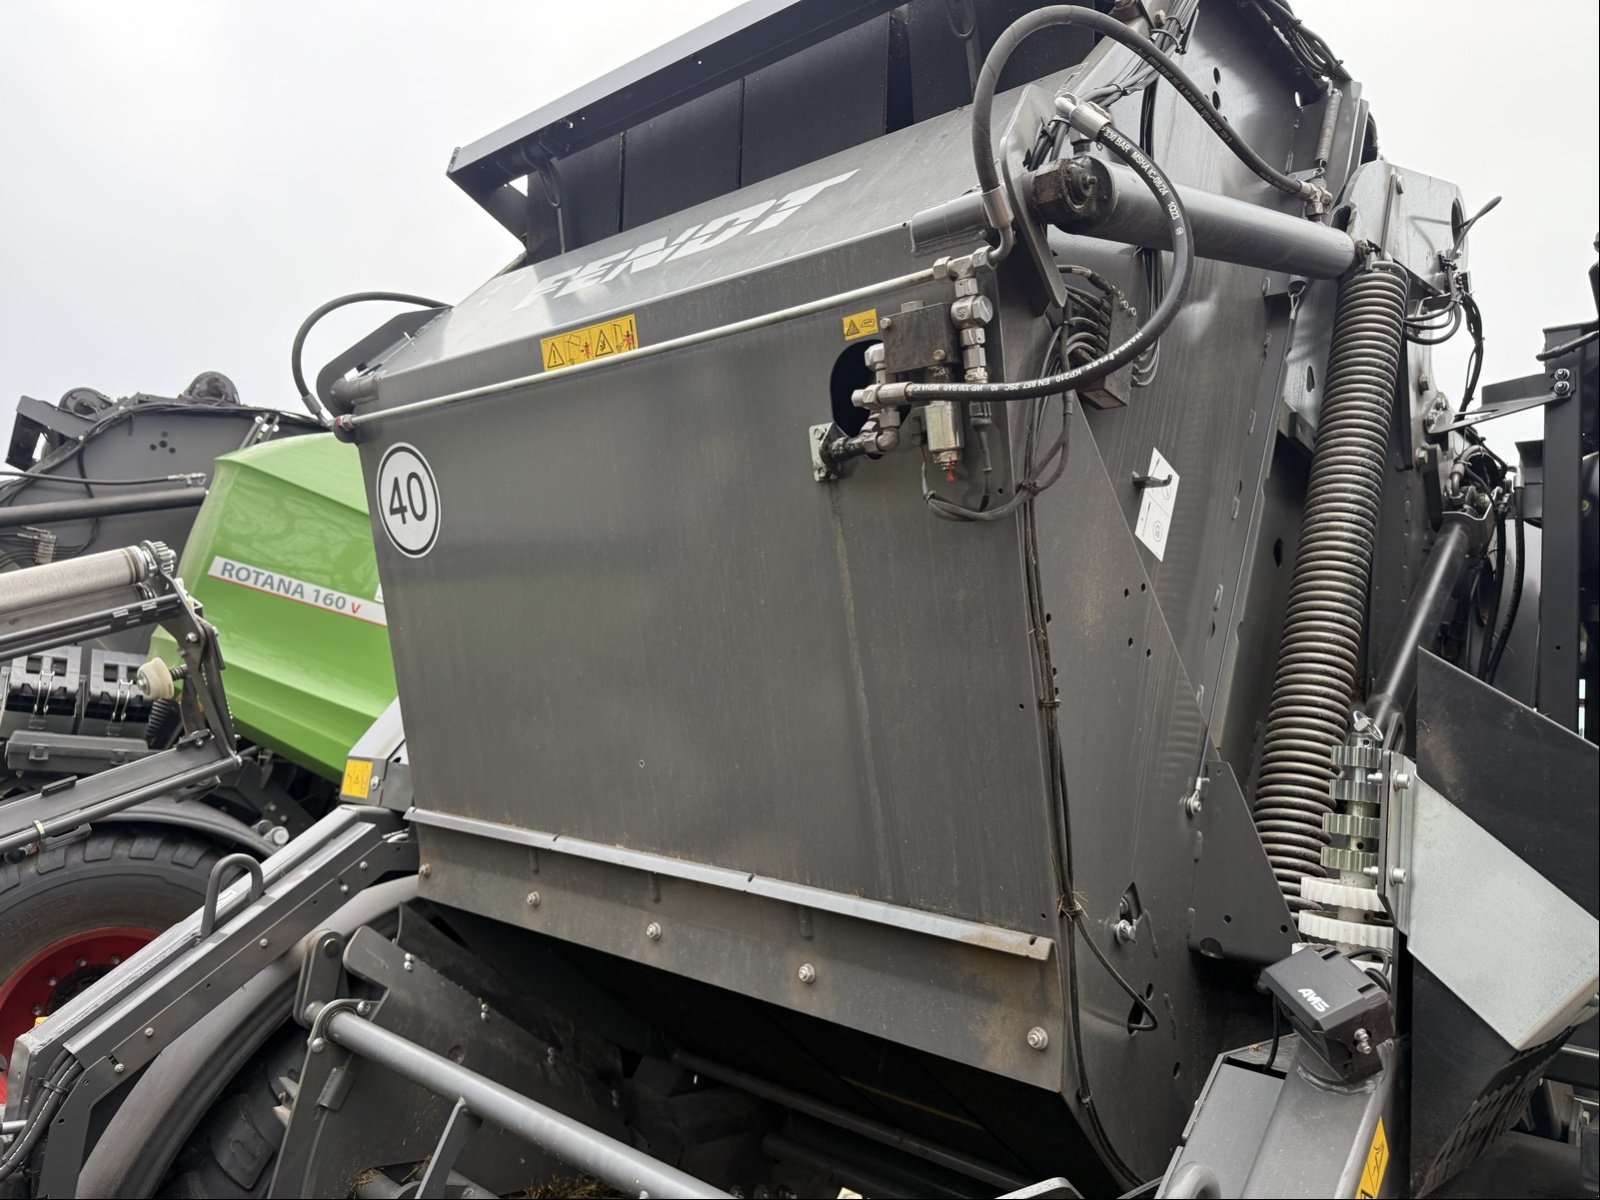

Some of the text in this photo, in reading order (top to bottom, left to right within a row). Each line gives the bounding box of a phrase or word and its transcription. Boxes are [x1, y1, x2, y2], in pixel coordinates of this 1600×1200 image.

[1103, 129, 1117, 142] 330
[1114, 138, 1131, 153] BAR
[1130, 151, 1150, 172] MSHA
[513, 169, 860, 311] FENDT
[1004, 383, 1020, 391] 2SC
[1022, 380, 1036, 389] 857
[1038, 378, 1050, 387] EN
[389, 472, 427, 525] 40
[220, 561, 305, 599] ROTANA
[313, 588, 346, 610] 160
